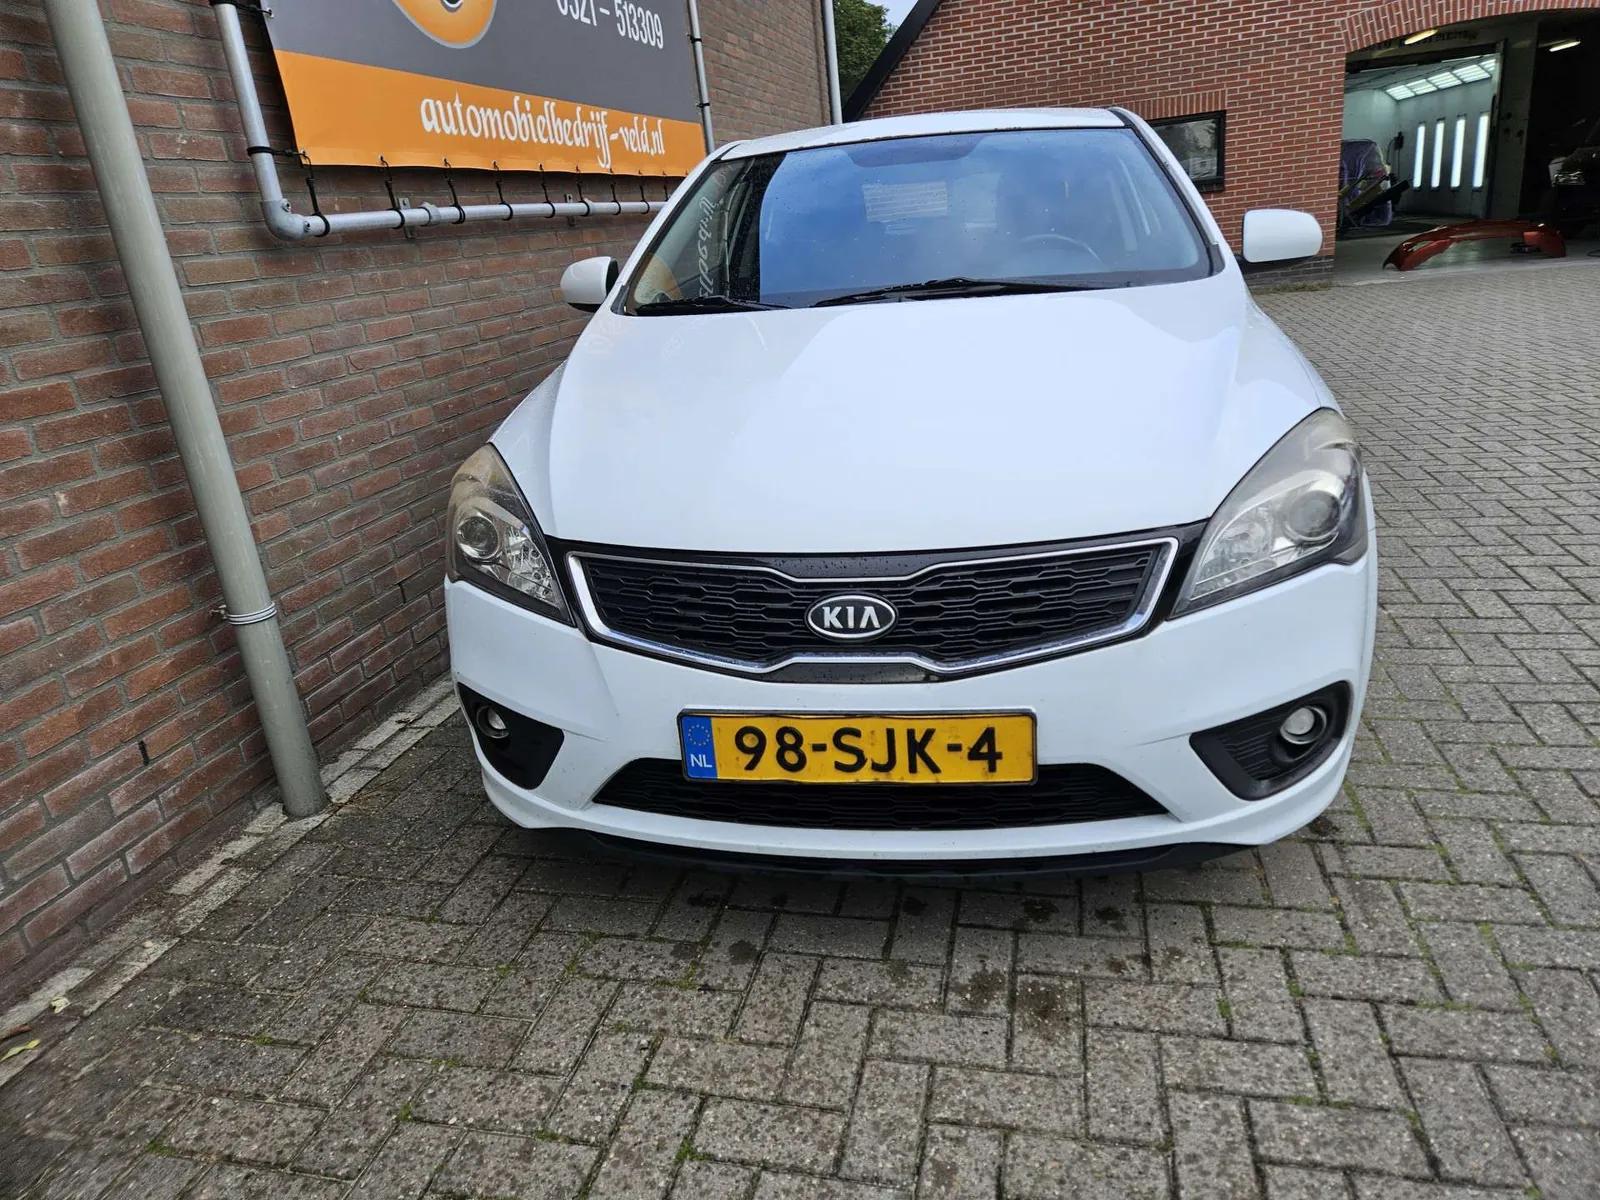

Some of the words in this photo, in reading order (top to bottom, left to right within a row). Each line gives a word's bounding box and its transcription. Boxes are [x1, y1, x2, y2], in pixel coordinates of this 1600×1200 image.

[614, 0, 664, 49] 513309
[420, 91, 665, 168] automobielbedrijf-veld.nl
[823, 606, 881, 629] KIA
[690, 754, 712, 769] NL
[734, 726, 1003, 774] 98-SJK-4
